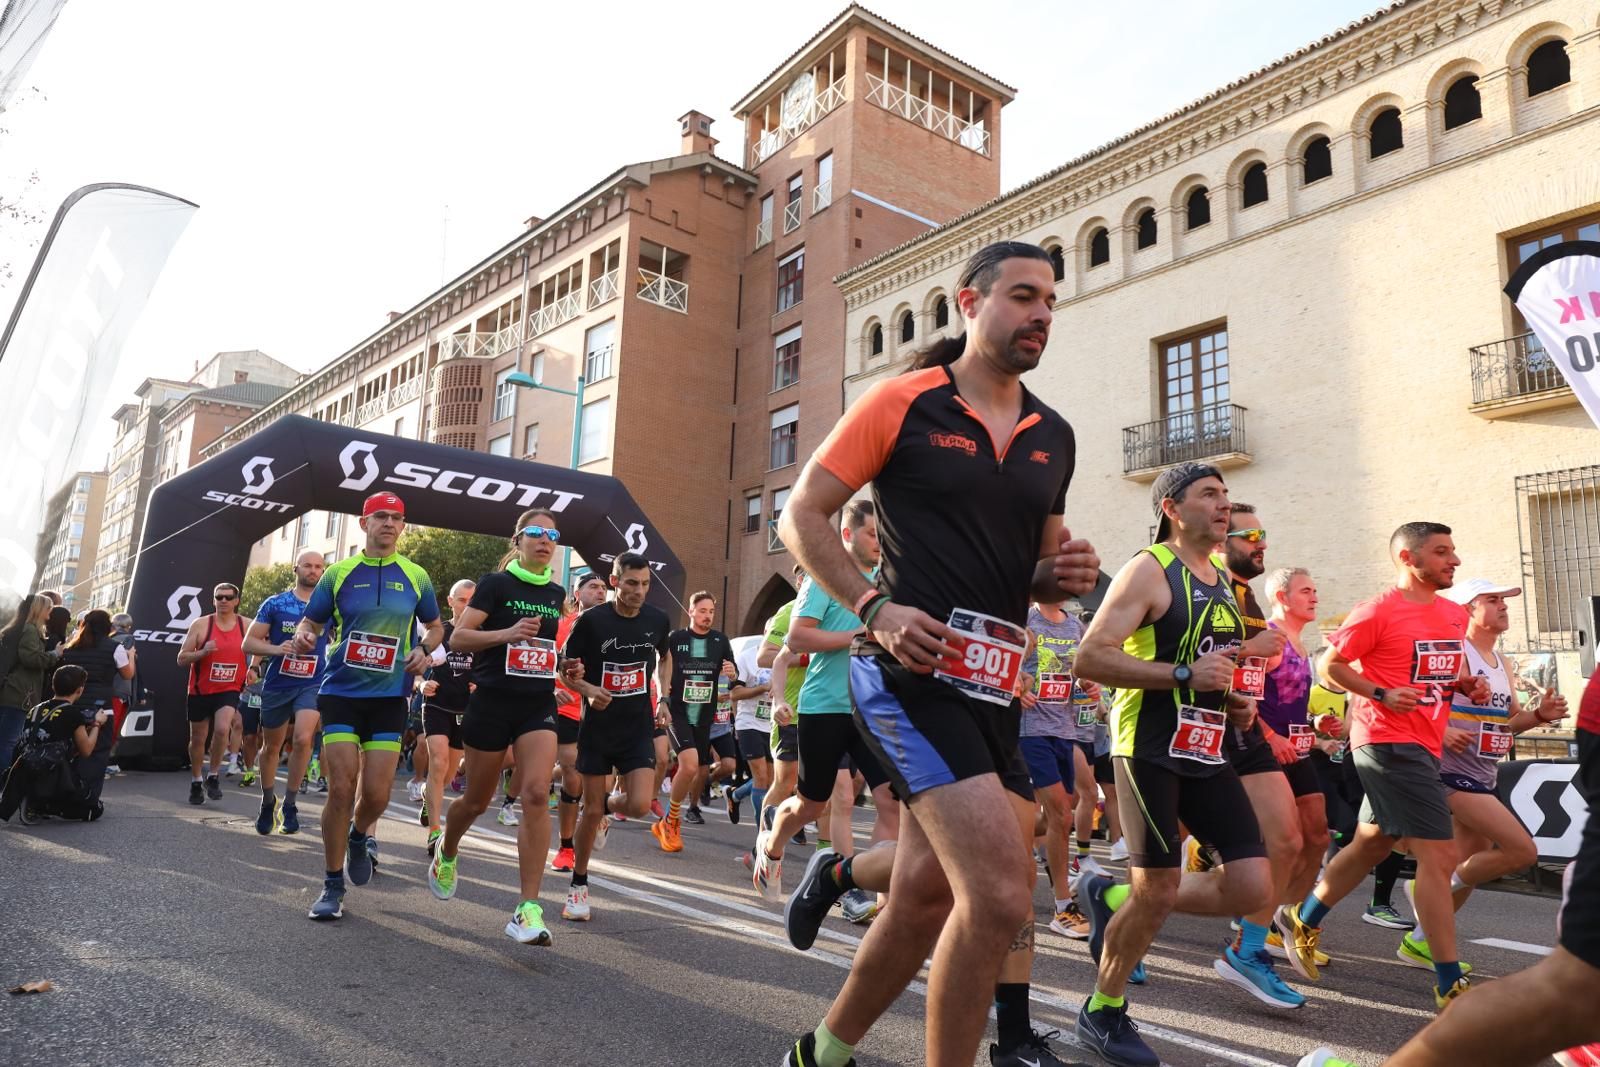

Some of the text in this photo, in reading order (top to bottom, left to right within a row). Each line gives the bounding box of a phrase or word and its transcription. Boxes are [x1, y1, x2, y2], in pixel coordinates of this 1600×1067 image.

[384, 461, 584, 512] SCOTT
[202, 490, 295, 514] SCOTT
[133, 629, 188, 644] SCO
[356, 645, 387, 660] 480
[518, 650, 548, 666] 424
[964, 643, 1011, 678] 901
[1428, 655, 1455, 670] 802
[611, 673, 638, 687] 828
[1046, 684, 1067, 694] 470
[1187, 727, 1215, 747] 679
[1490, 735, 1510, 748] 556
